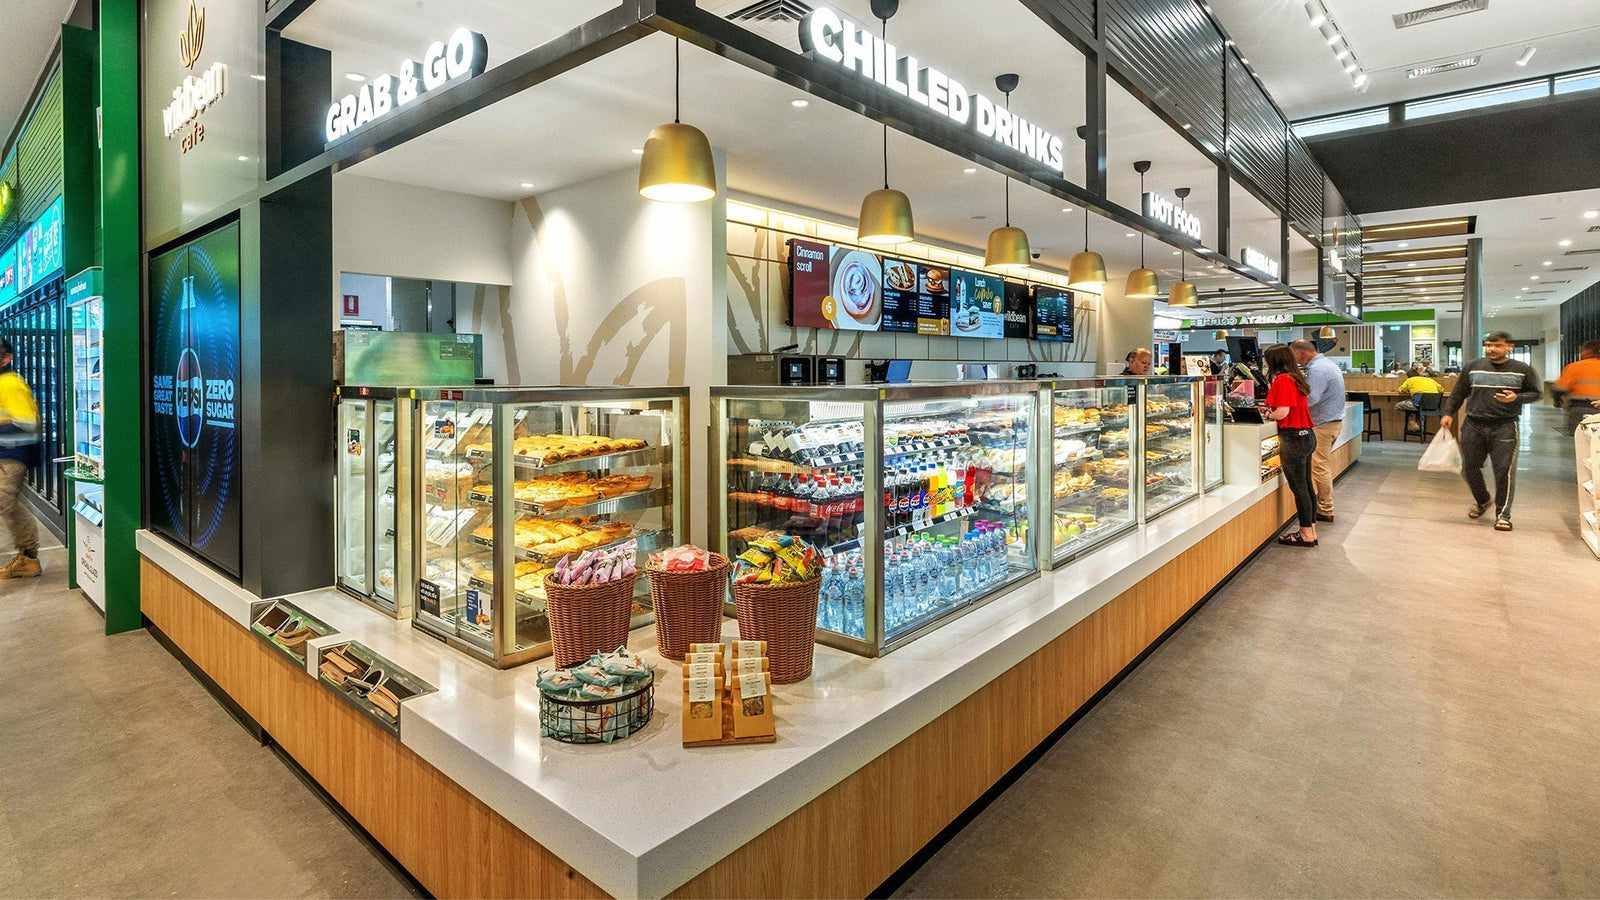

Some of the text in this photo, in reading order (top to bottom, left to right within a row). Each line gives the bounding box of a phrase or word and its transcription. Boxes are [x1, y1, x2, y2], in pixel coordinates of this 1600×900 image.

[325, 26, 475, 143] GRAB & GO
[808, 7, 1064, 172] CHILLED DRINKS
[1149, 191, 1201, 240] HOT FOOD
[796, 245, 824, 261] Cinnamon
[796, 261, 813, 273] scroll
[153, 374, 173, 389] SAME
[206, 379, 234, 401] ZERO
[153, 389, 173, 402] GREAT
[177, 386, 202, 410] PEPSI
[153, 402, 174, 416] TASTE
[206, 402, 235, 420] SUGAR
